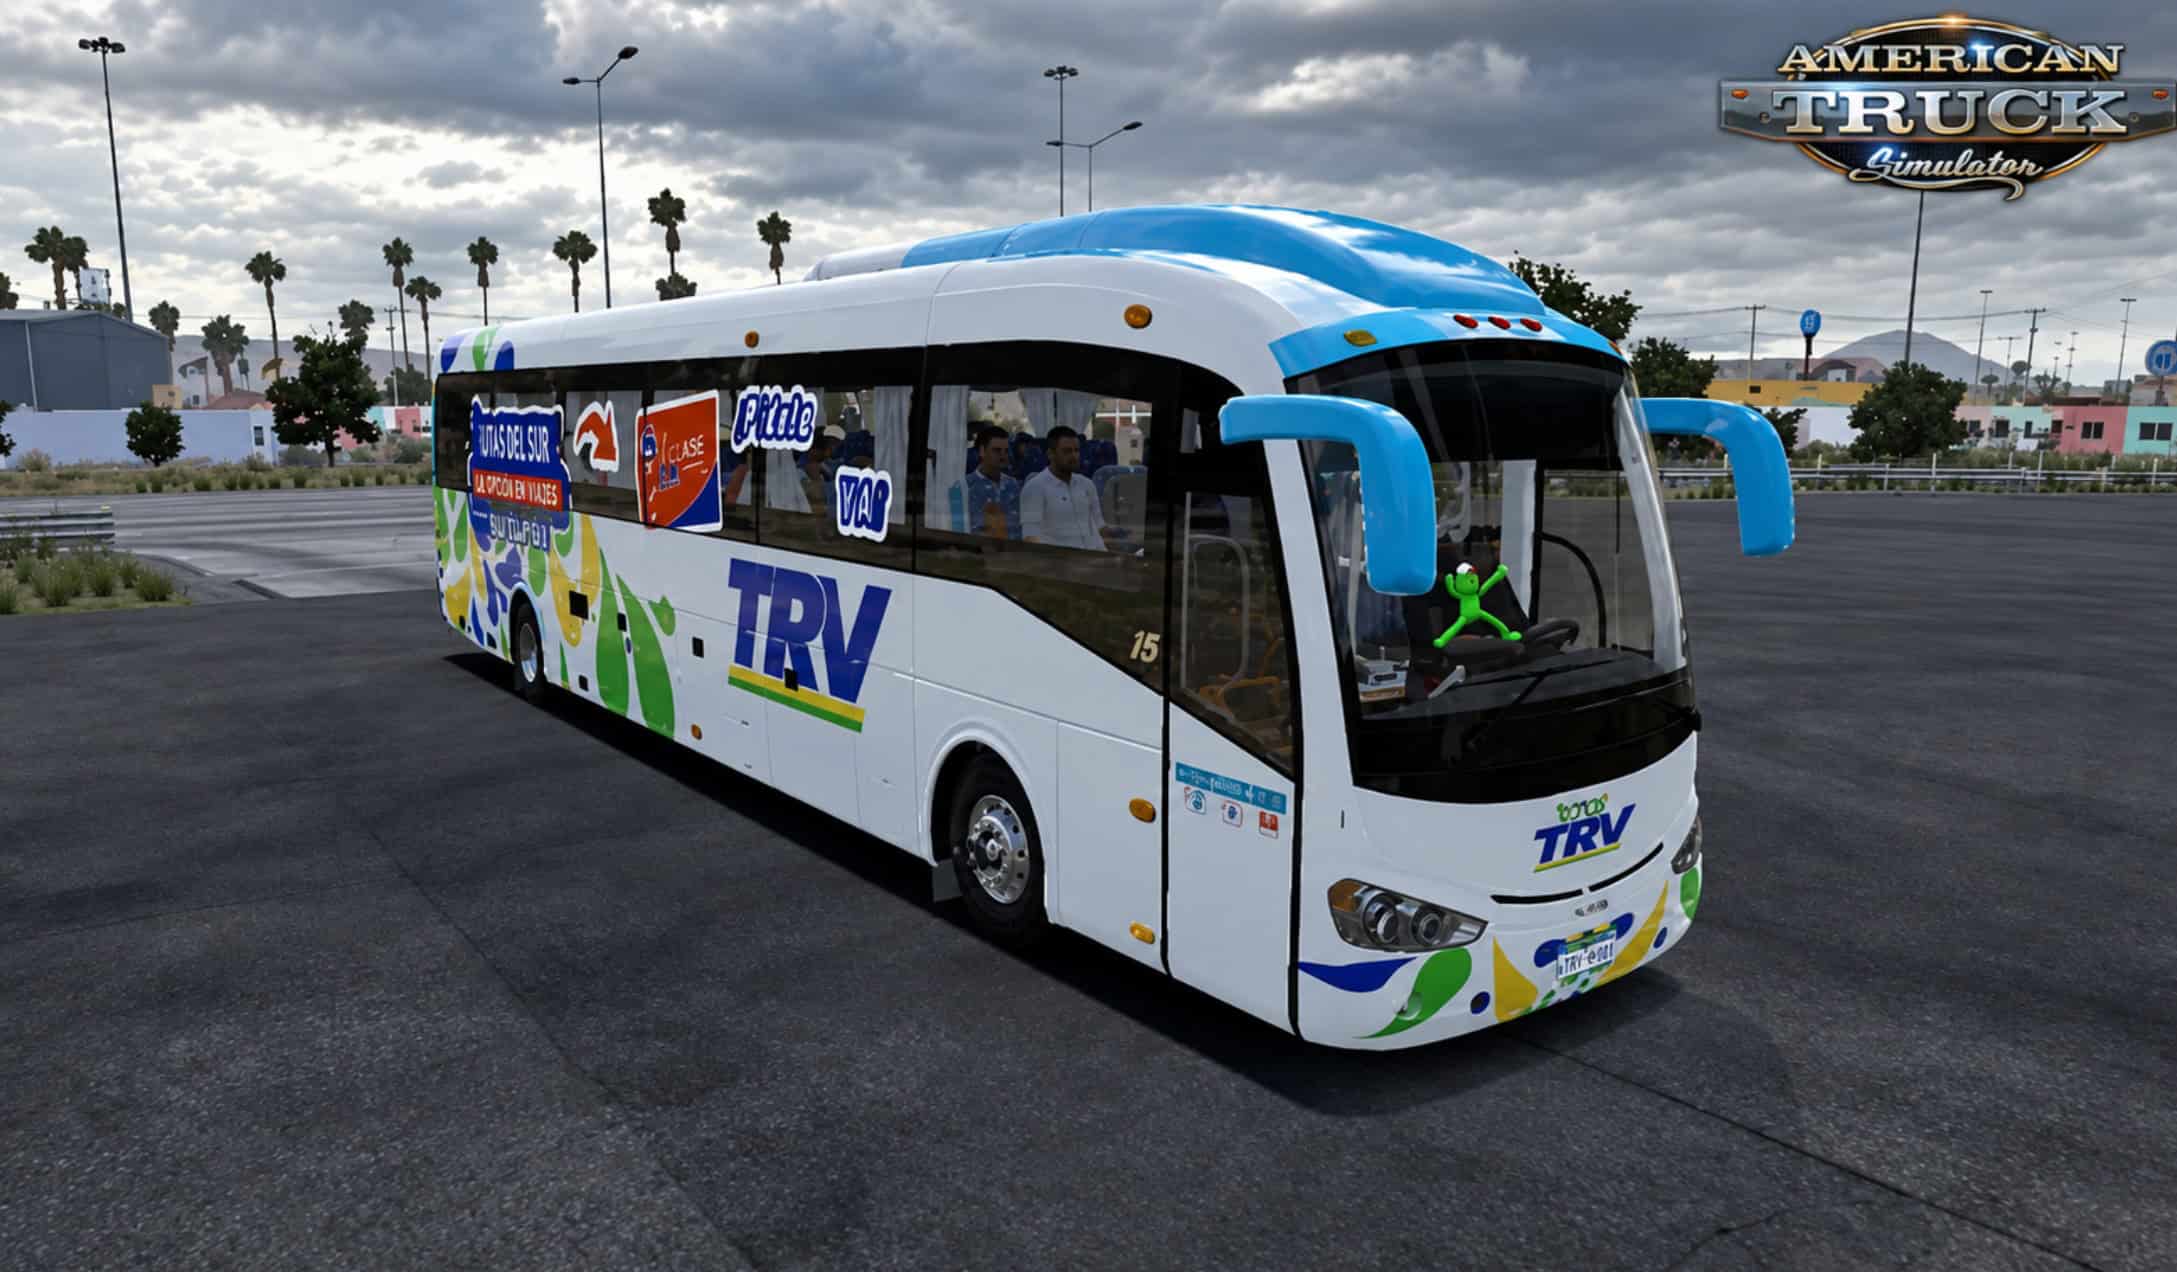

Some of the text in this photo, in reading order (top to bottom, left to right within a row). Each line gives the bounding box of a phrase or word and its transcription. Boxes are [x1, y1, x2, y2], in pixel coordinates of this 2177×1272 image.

[506, 424, 526, 462] DEL
[527, 425, 550, 464] SUR
[669, 434, 704, 463] CLASE
[475, 473, 486, 494] LA
[514, 479, 527, 501] EN
[528, 480, 559, 507] VIAJES
[728, 558, 892, 704] TRV
[1129, 629, 1161, 664] 15
[1534, 803, 1637, 865] TRV
